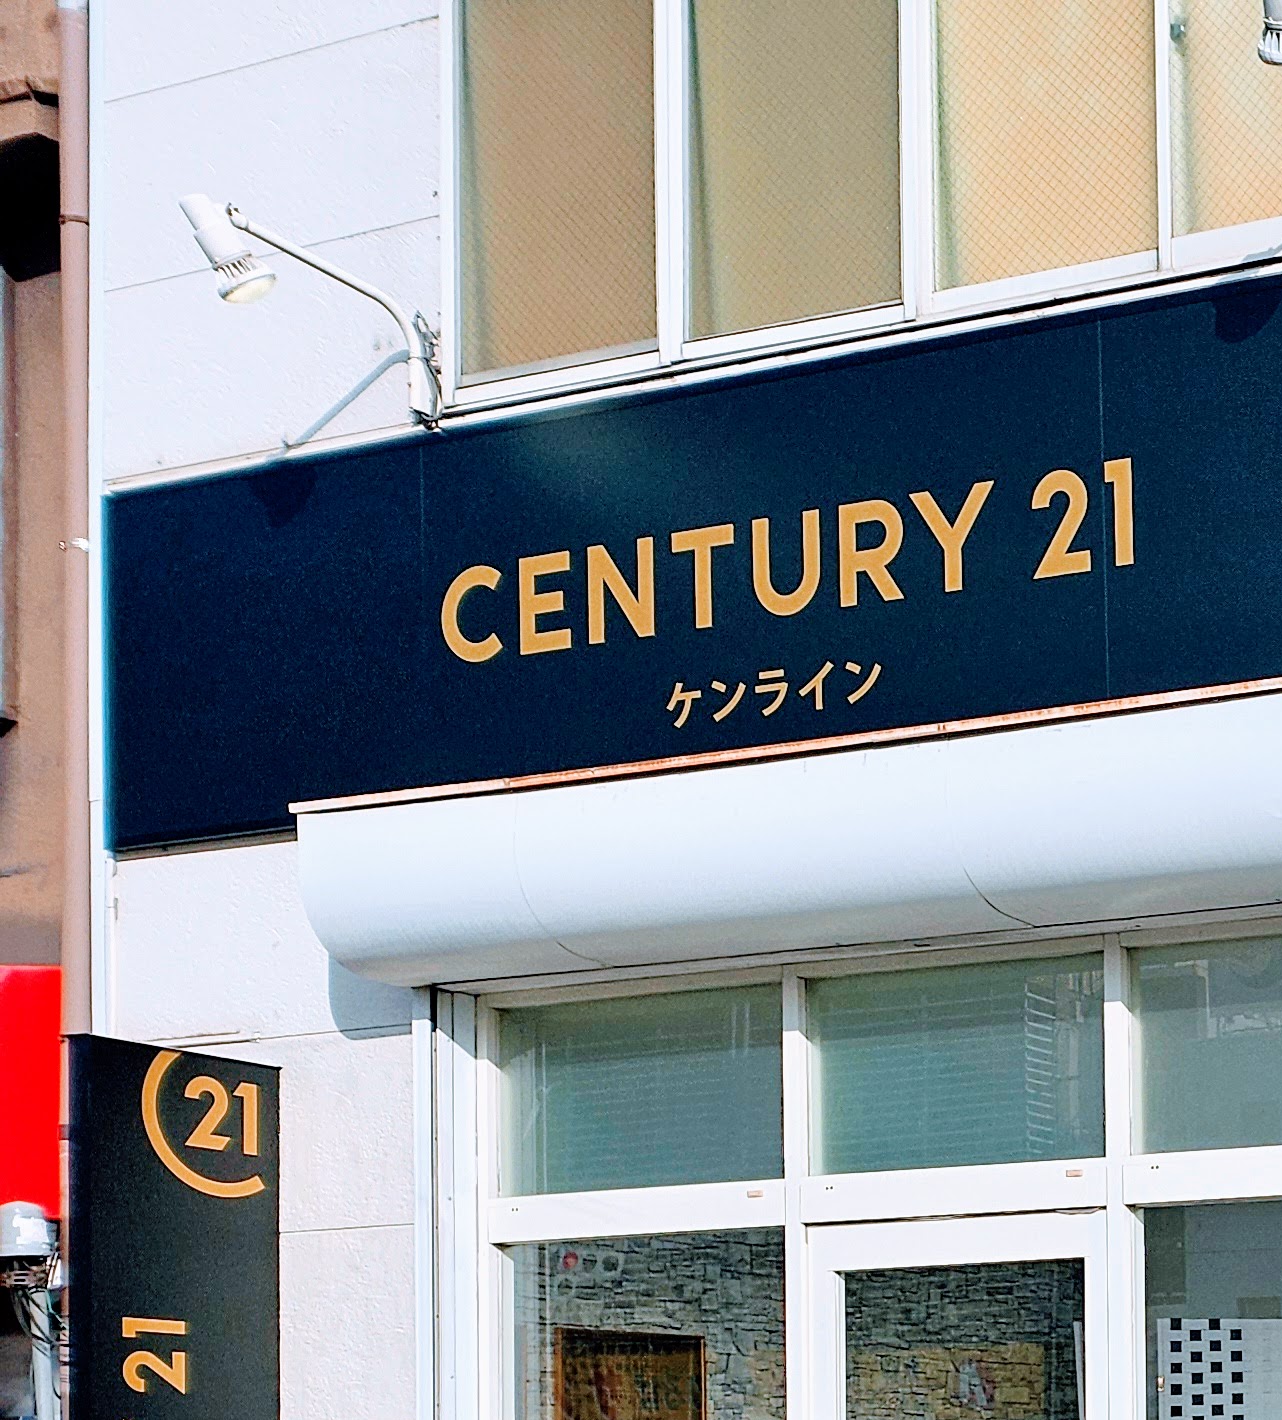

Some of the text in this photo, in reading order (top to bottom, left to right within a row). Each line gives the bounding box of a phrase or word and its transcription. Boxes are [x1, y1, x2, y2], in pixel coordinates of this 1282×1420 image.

[441, 457, 1135, 663] CENTURY 21
[667, 660, 882, 729] ケンライン
[122, 1315, 189, 1395] 21
